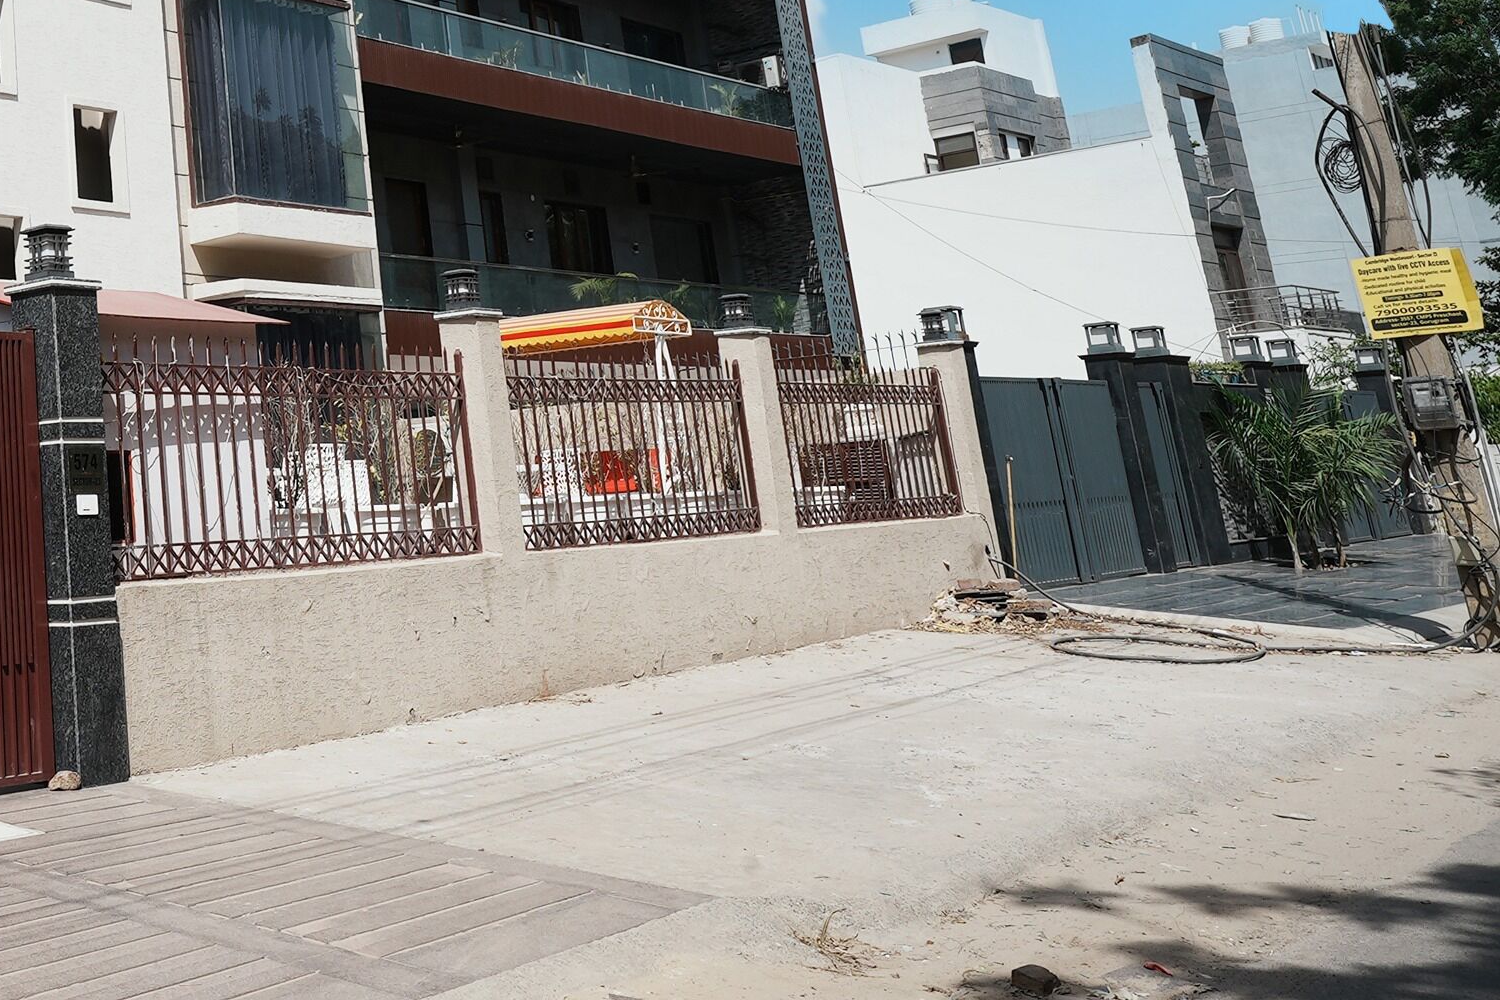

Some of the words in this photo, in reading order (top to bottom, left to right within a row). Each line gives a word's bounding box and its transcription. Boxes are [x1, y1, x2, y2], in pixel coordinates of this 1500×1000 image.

[1358, 267, 1382, 276] Daycare
[1397, 262, 1409, 270] live
[1410, 261, 1426, 269] CCTV
[1428, 259, 1450, 267] Access
[1375, 302, 1457, 317] 7900093535
[74, 453, 98, 470] 574
